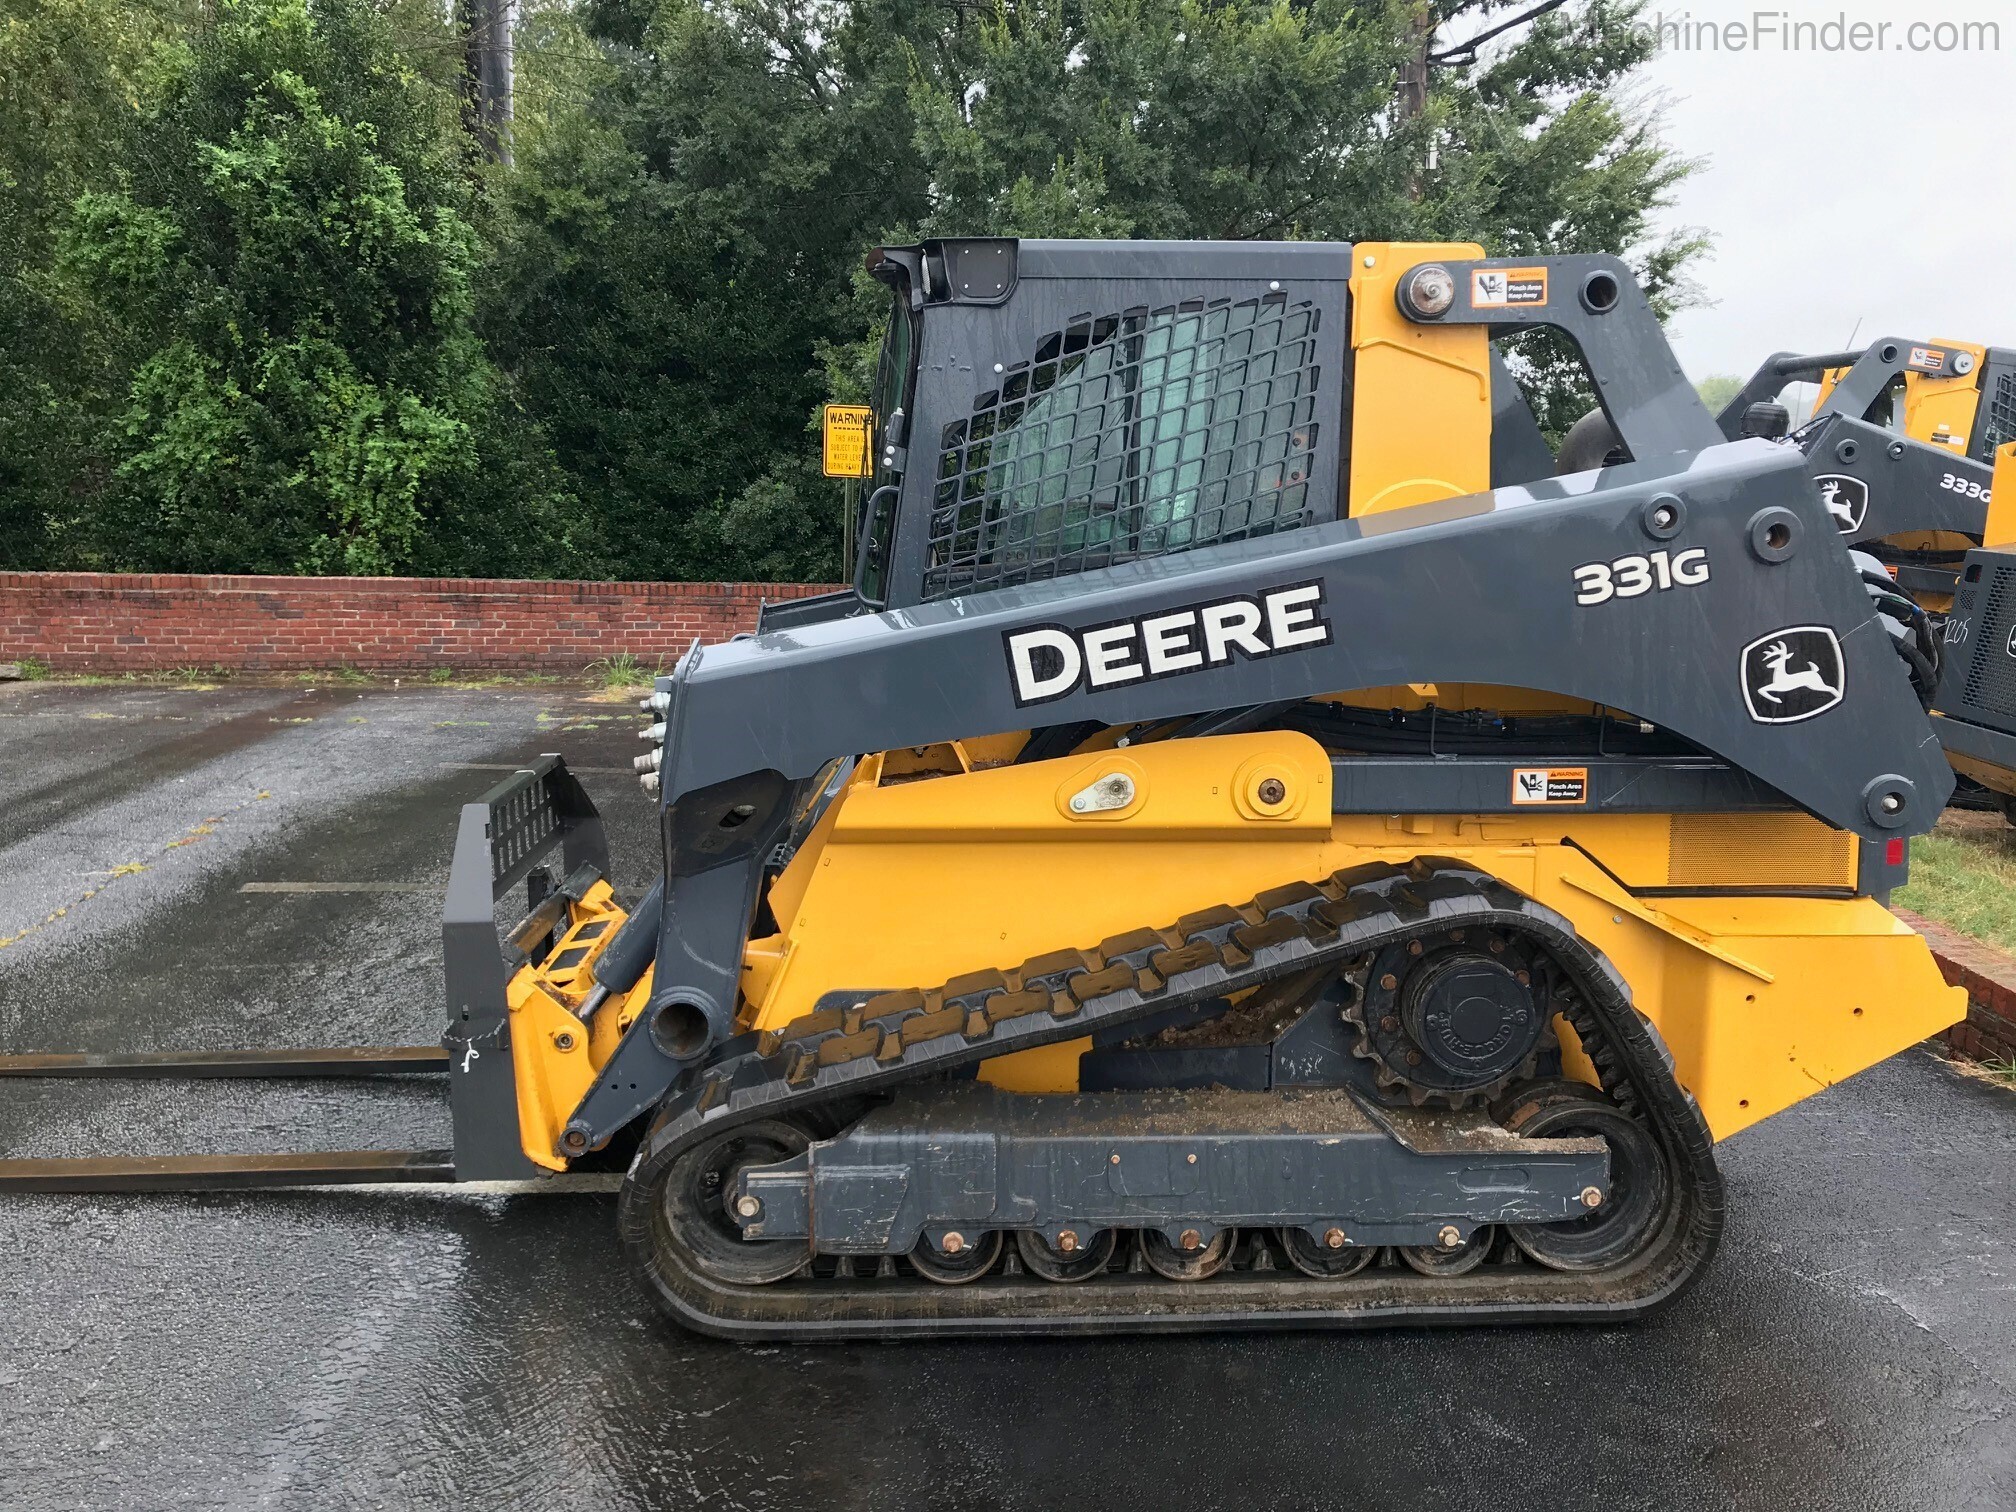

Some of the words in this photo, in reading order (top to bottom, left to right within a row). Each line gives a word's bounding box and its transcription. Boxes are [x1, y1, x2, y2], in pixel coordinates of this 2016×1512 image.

[835, 434, 846, 443] THIS
[830, 444, 851, 452] SUBJECT
[834, 453, 848, 461] WATER
[828, 462, 844, 470] DURING
[1573, 548, 1710, 605] 331G
[1009, 585, 1327, 702] DEERE
